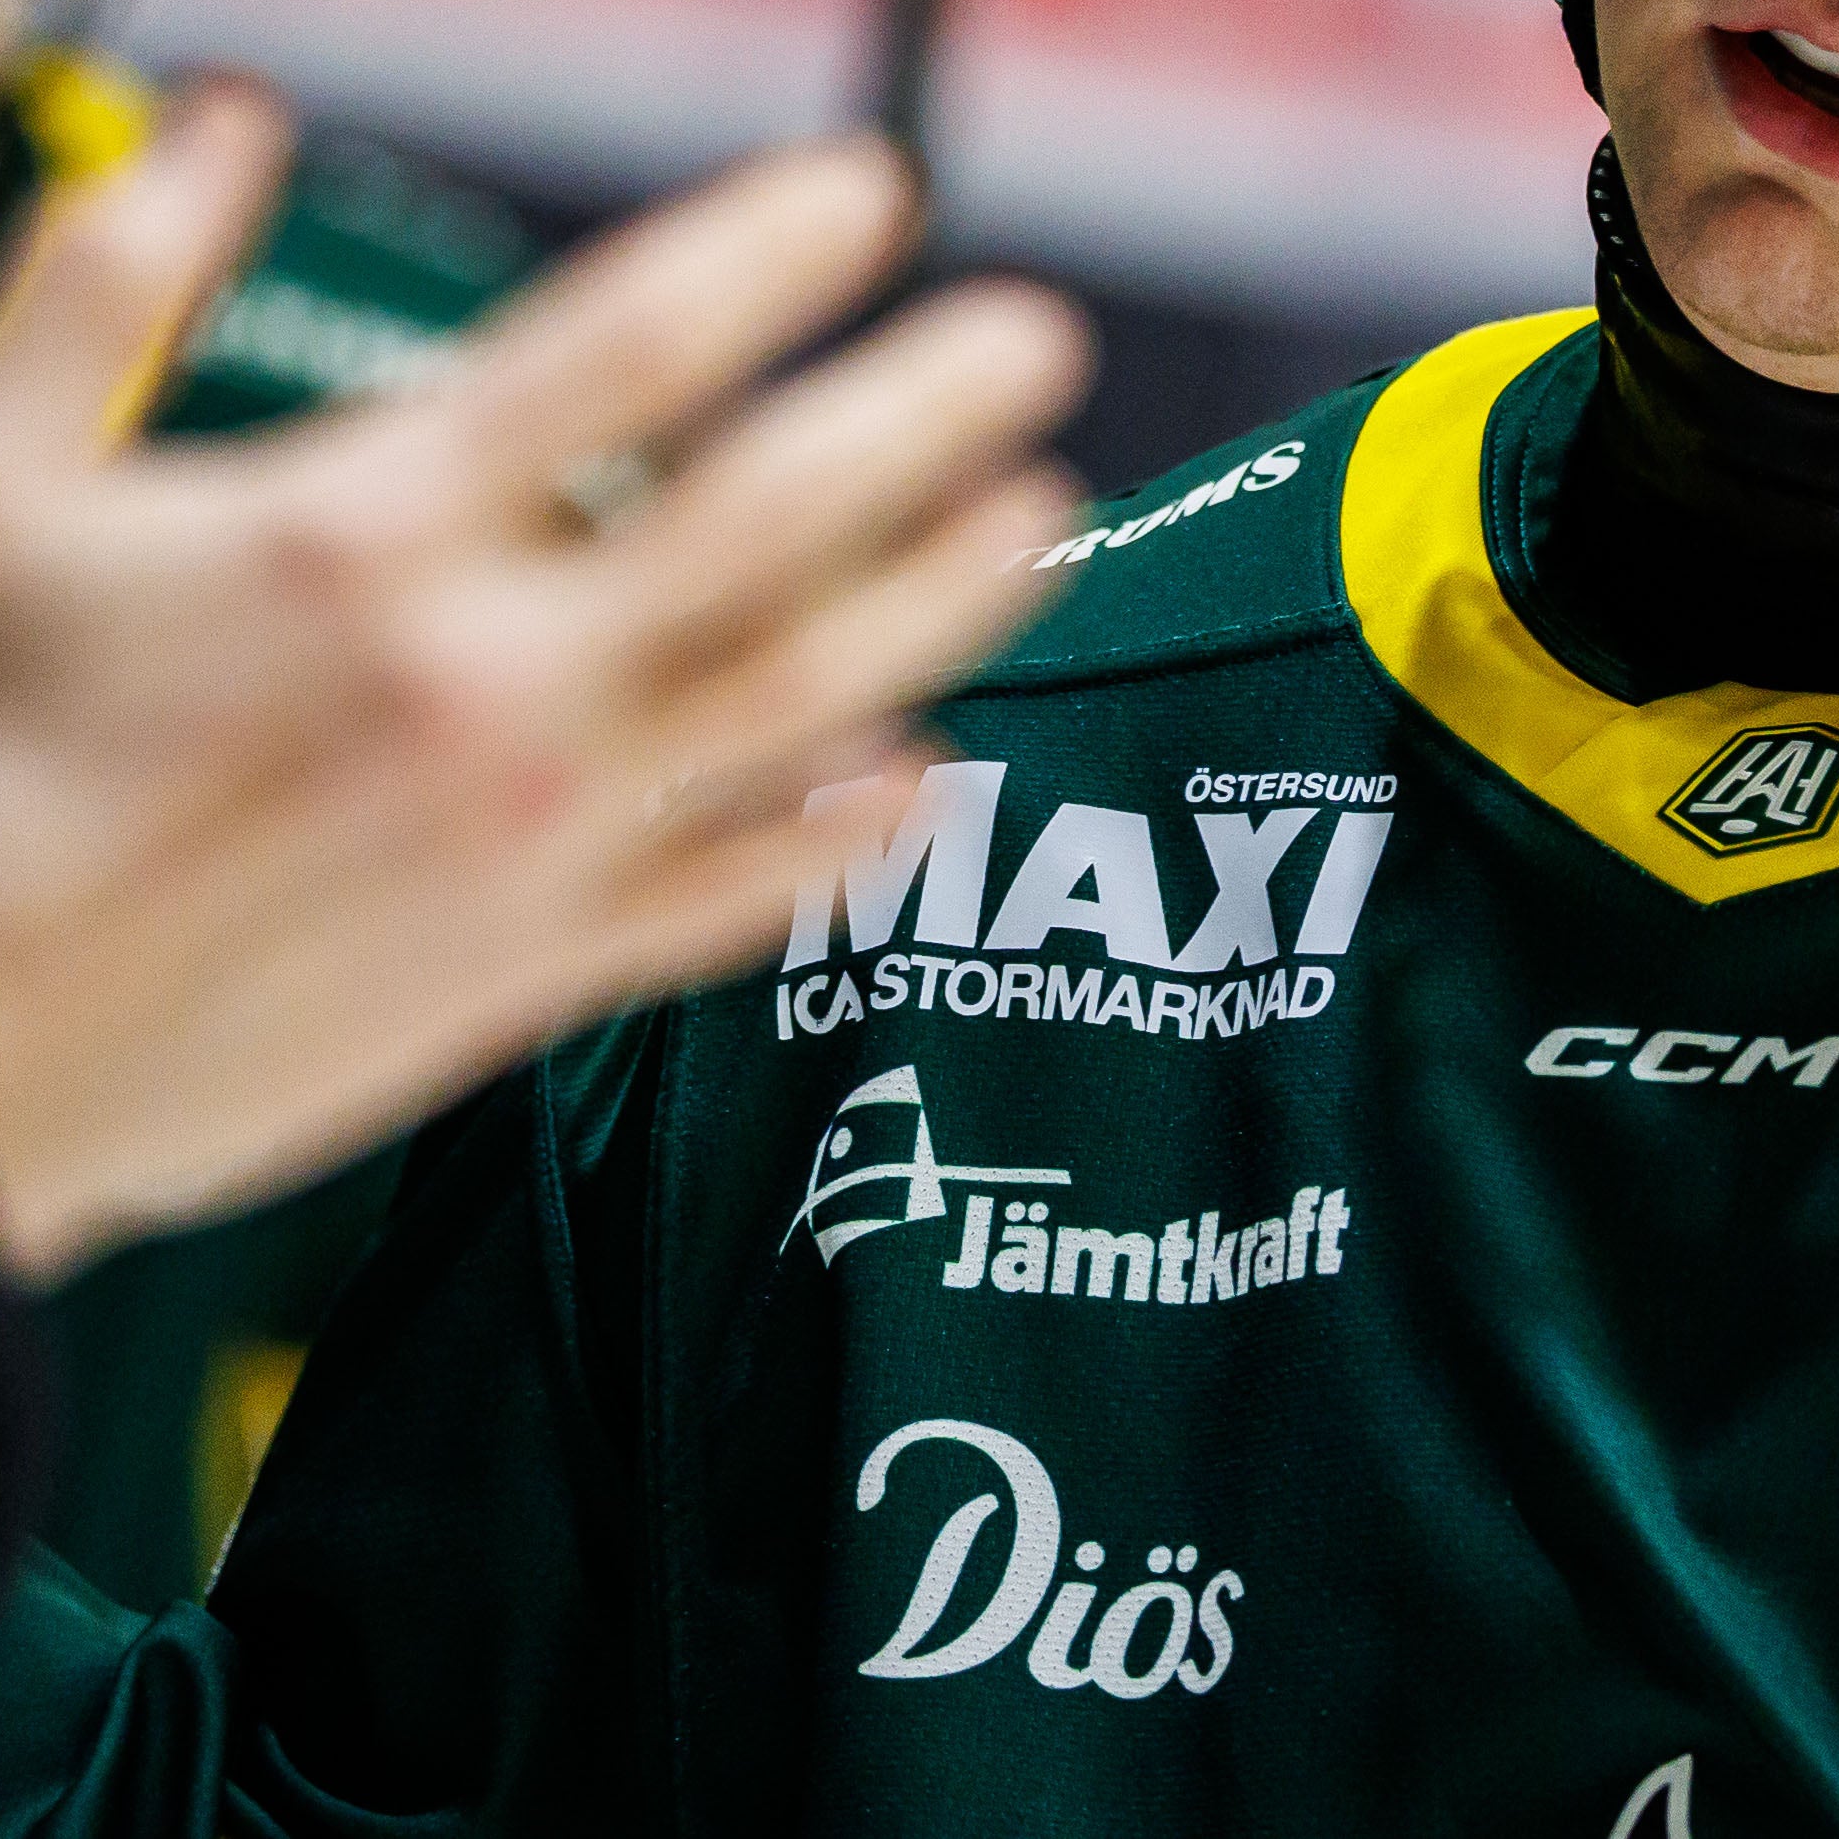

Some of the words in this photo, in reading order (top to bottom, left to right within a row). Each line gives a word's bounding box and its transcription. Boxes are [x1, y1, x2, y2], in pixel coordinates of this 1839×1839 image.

[1184, 767, 1398, 804] ÖSTERSUND
[781, 760, 1395, 974] MAXI
[775, 970, 866, 1042] ICA
[869, 953, 1337, 1042] STORMARKNAD
[941, 1184, 1352, 1306] Jämtkraft
[855, 1418, 1245, 1700] Diös
